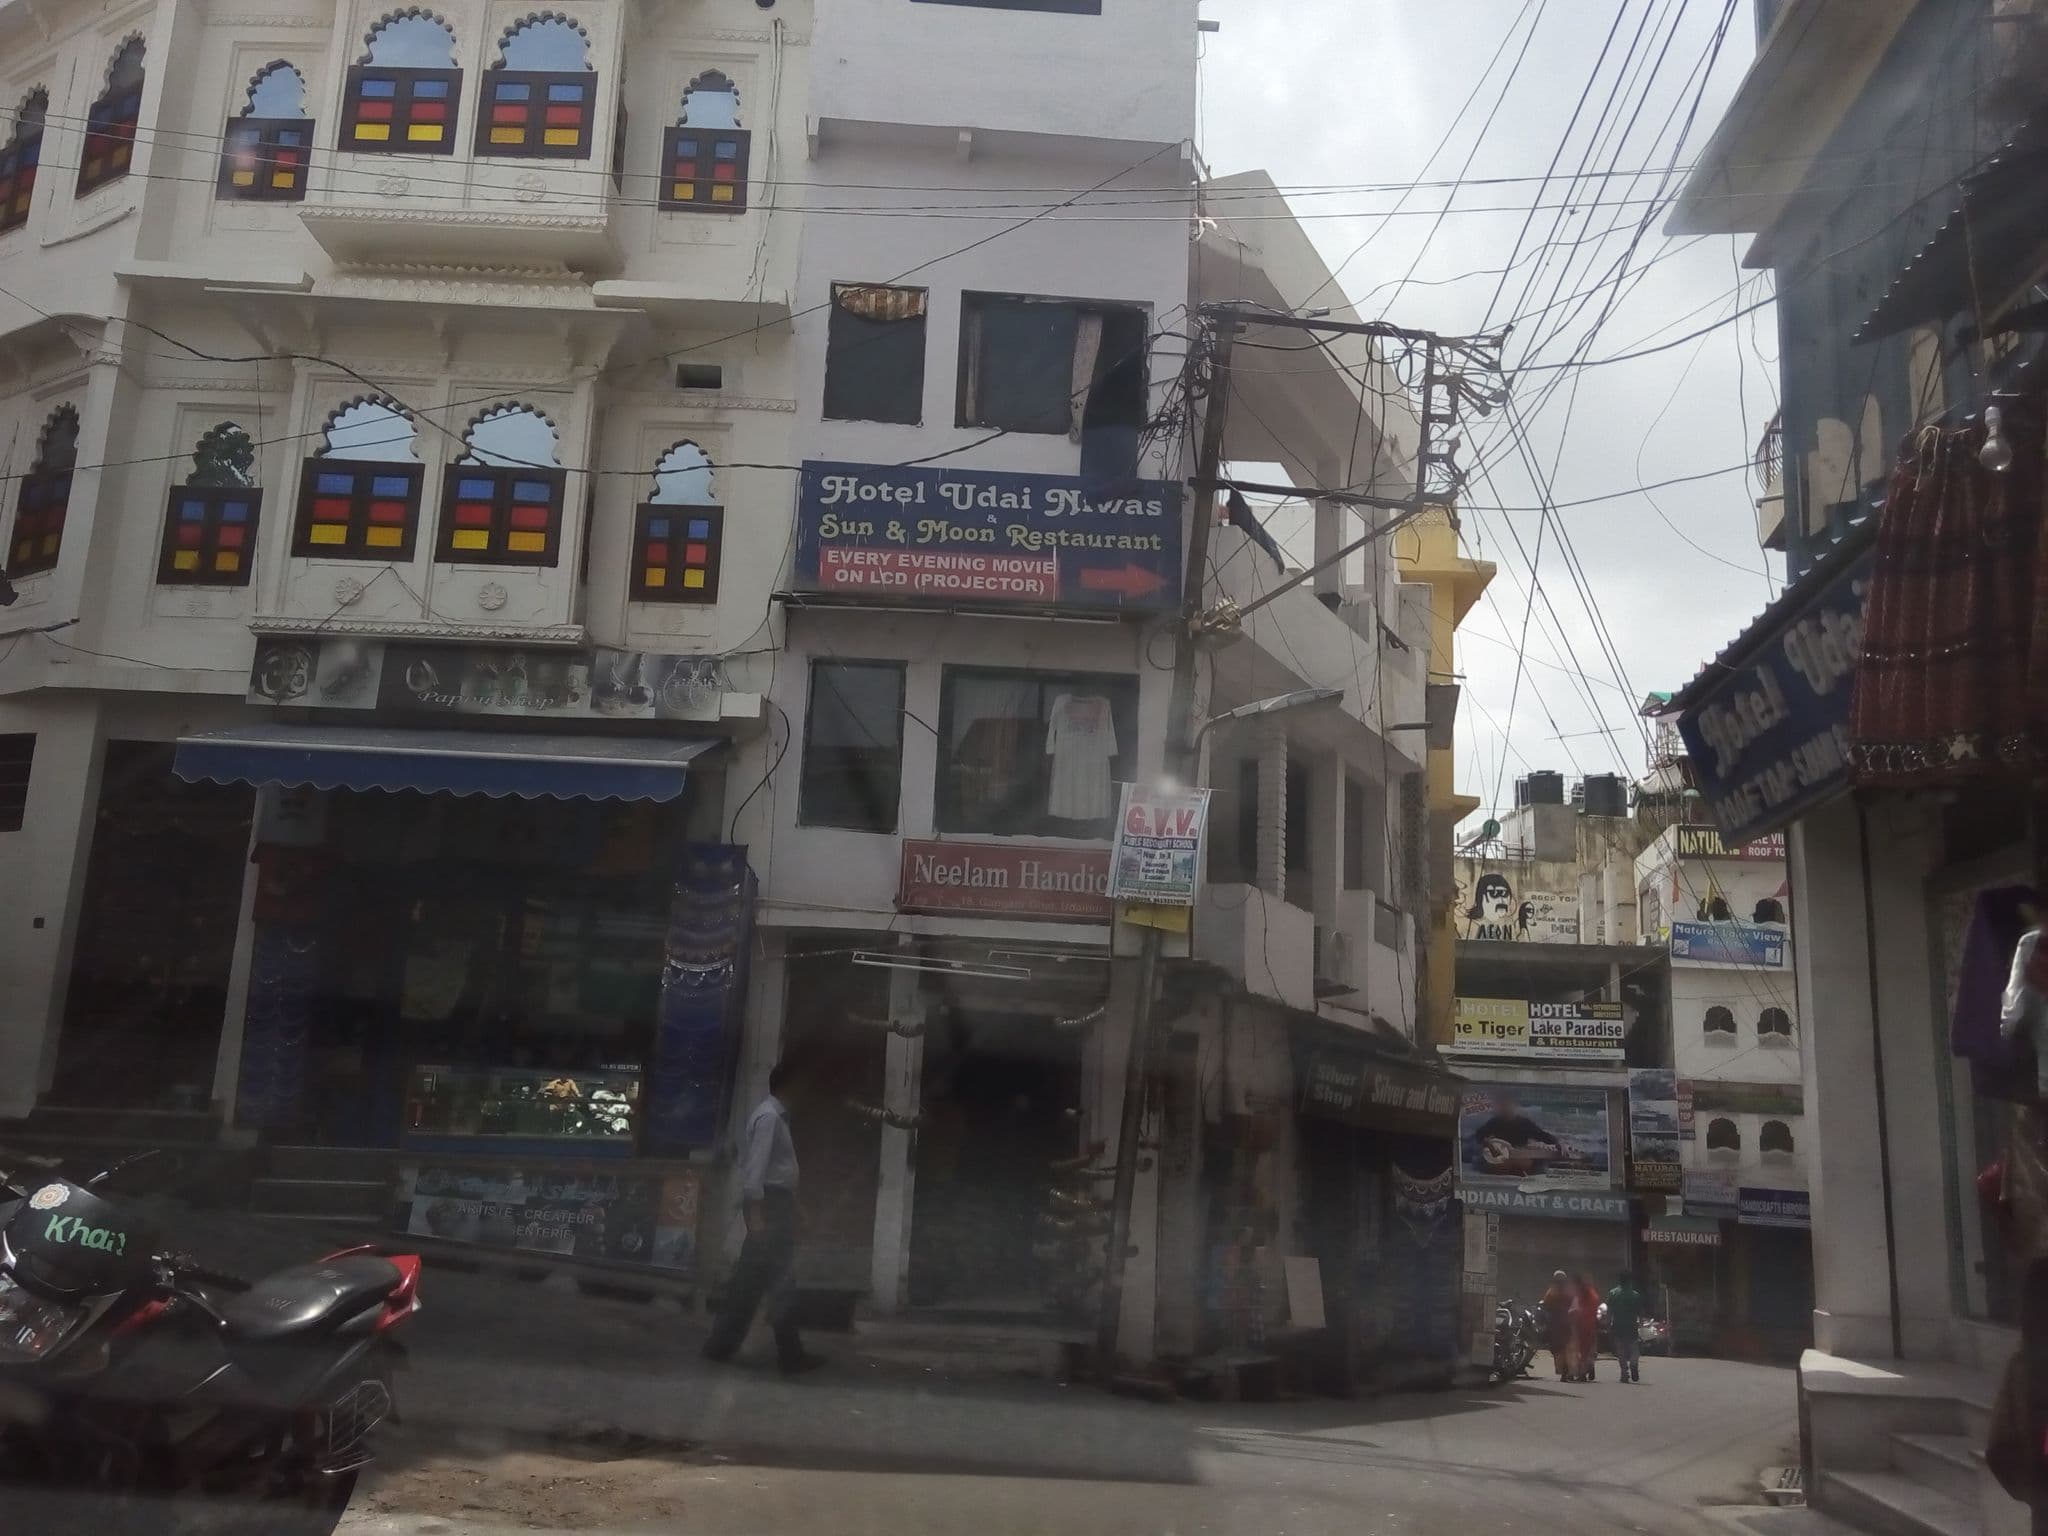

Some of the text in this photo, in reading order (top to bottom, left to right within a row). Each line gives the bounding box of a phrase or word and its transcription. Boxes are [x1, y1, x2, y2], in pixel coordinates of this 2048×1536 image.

[820, 476, 926, 504] Hotel
[939, 483, 1032, 510] Udai
[987, 514, 997, 524] &
[819, 514, 1161, 551] Sun & Moon Restaurant
[827, 550, 1055, 575] EVERY EVENING MOVIE
[835, 569, 1045, 595] ON LCD (PROJECTOR)
[1126, 805, 1198, 838] G.V.V.
[1748, 846, 1772, 857] ROOF
[914, 855, 1009, 889] Neelam
[1753, 931, 1782, 942] View
[1464, 1002, 1519, 1017] HOTEL
[1530, 1003, 1582, 1018] HOTEL
[1478, 1020, 1525, 1039] Tiger
[1531, 1021, 1623, 1038] Lake Paradise
[1536, 1038, 1546, 1047] &
[1550, 1038, 1618, 1048] Restaurant
[1512, 1194, 1547, 1209] ART
[1552, 1197, 1566, 1209] &
[1568, 1198, 1628, 1214] CRAFT
[1651, 1231, 1720, 1246] RESTAURANT
